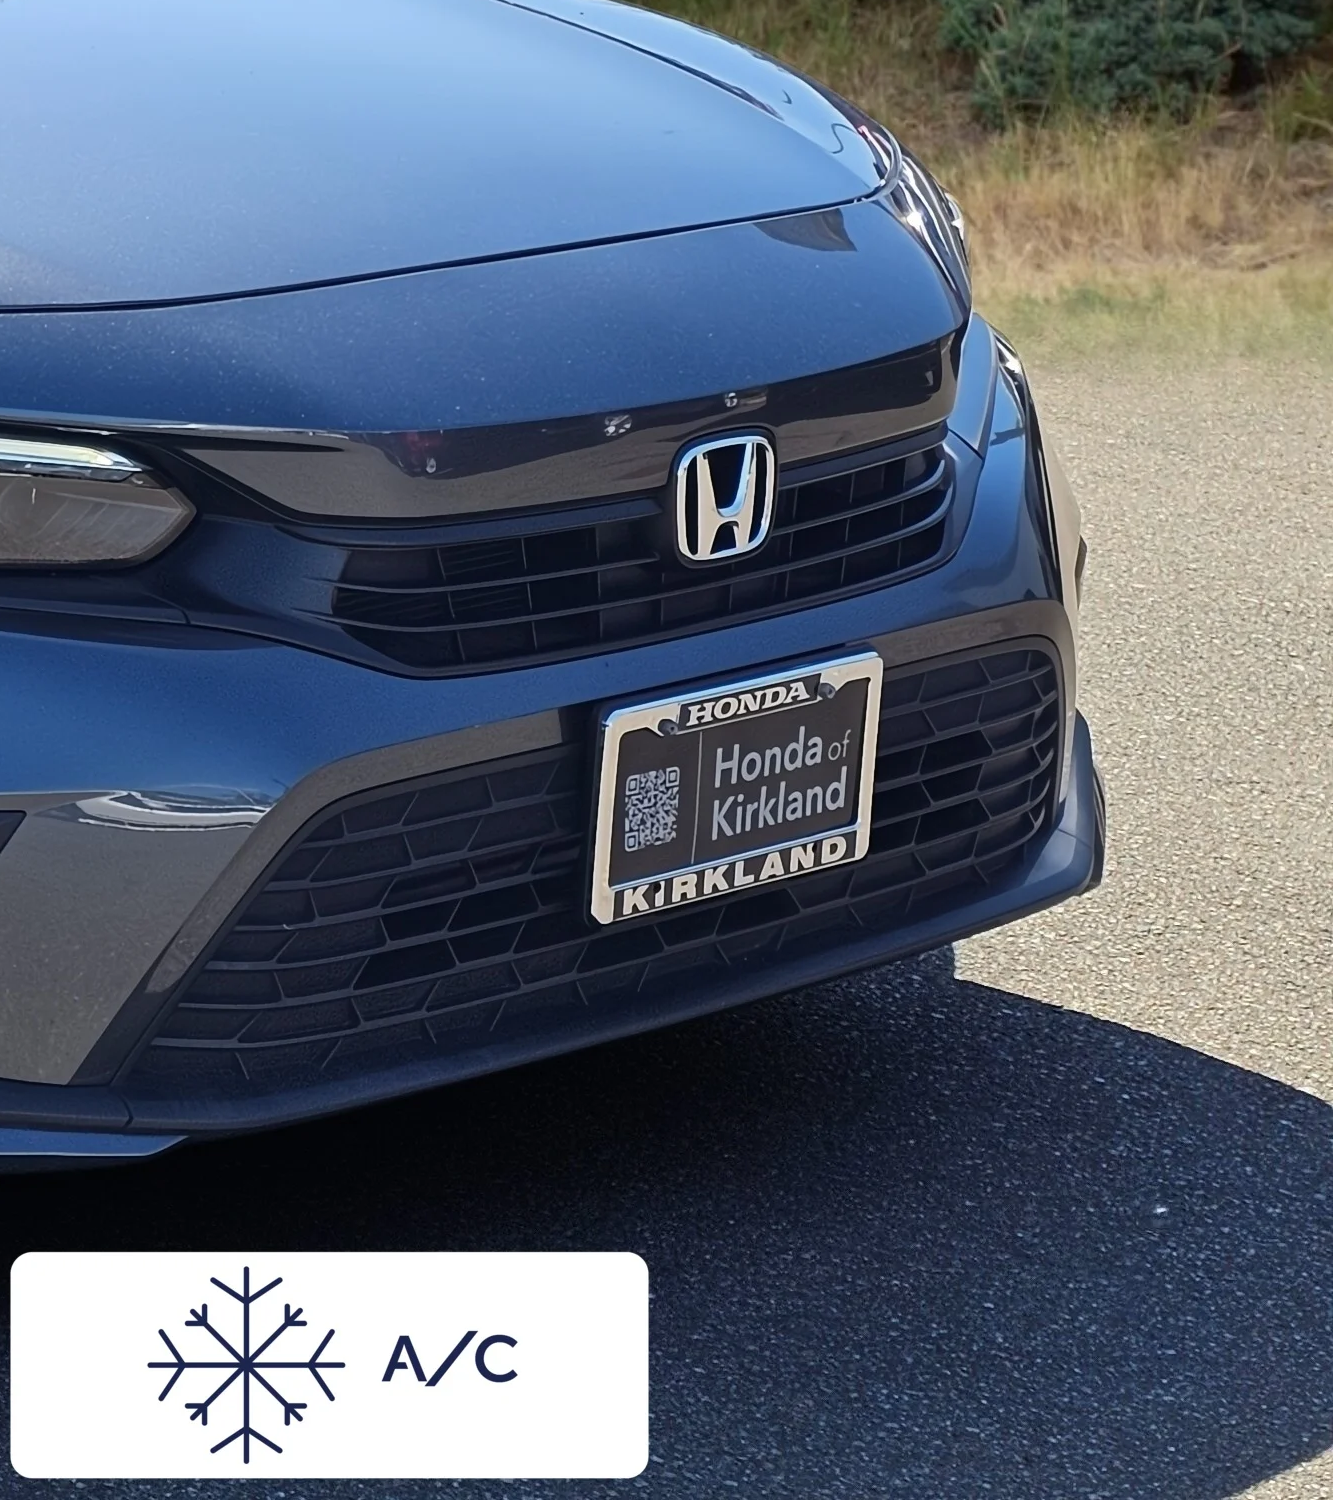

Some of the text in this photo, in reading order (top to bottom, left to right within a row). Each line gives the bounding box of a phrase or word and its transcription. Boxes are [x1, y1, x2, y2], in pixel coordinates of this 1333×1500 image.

[686, 681, 810, 726] HONDA
[714, 726, 851, 788] Honda of
[711, 766, 848, 841] Kirkland
[622, 836, 847, 916] KIRKLAND
